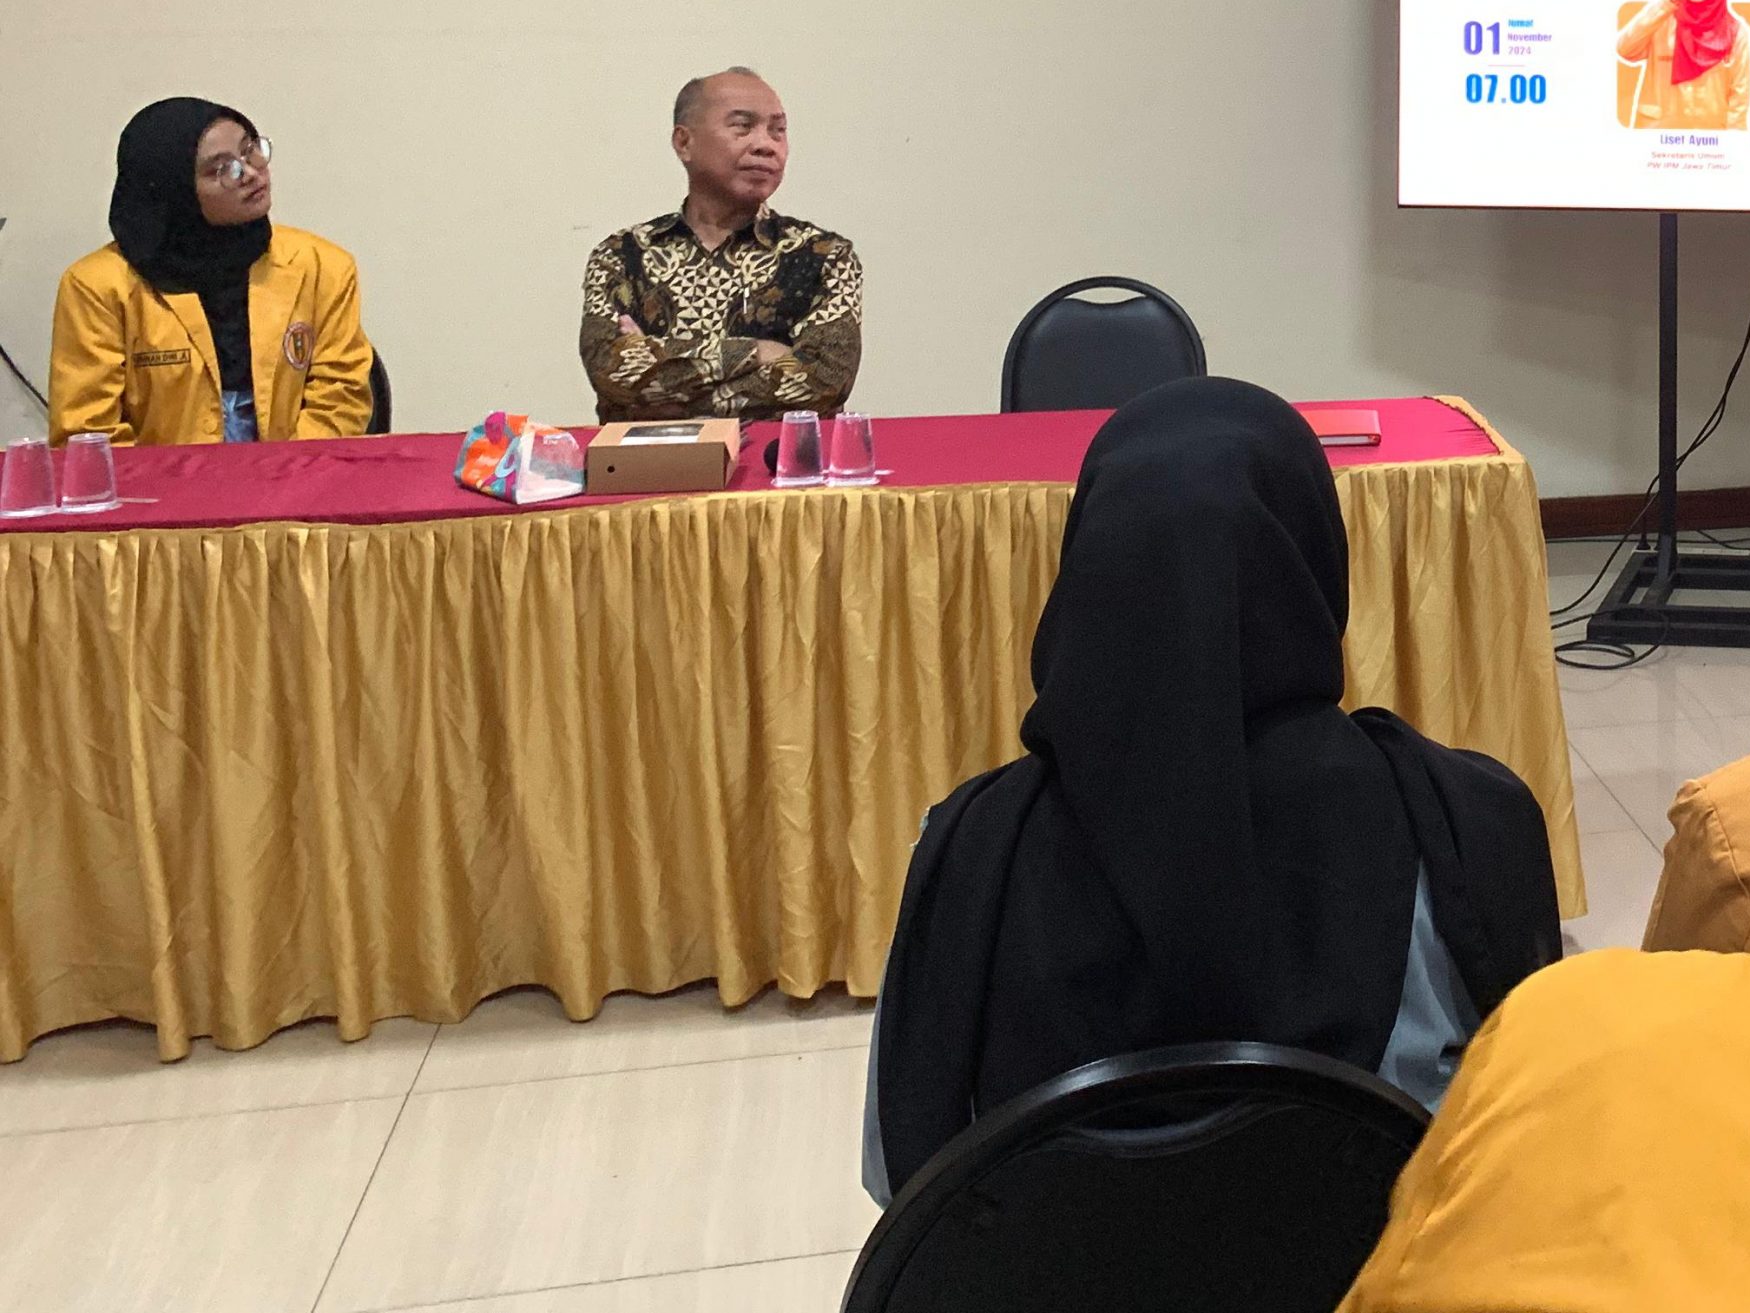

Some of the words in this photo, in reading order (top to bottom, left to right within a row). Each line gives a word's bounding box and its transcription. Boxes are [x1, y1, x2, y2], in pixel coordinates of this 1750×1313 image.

[1464, 21, 1500, 55] 01
[1507, 32, 1552, 42] November
[1508, 45, 1532, 56] 2024
[1466, 74, 1547, 104] 07.00
[1689, 134, 1719, 147] Ayuni
[1651, 151, 1695, 160] Sekretaris
